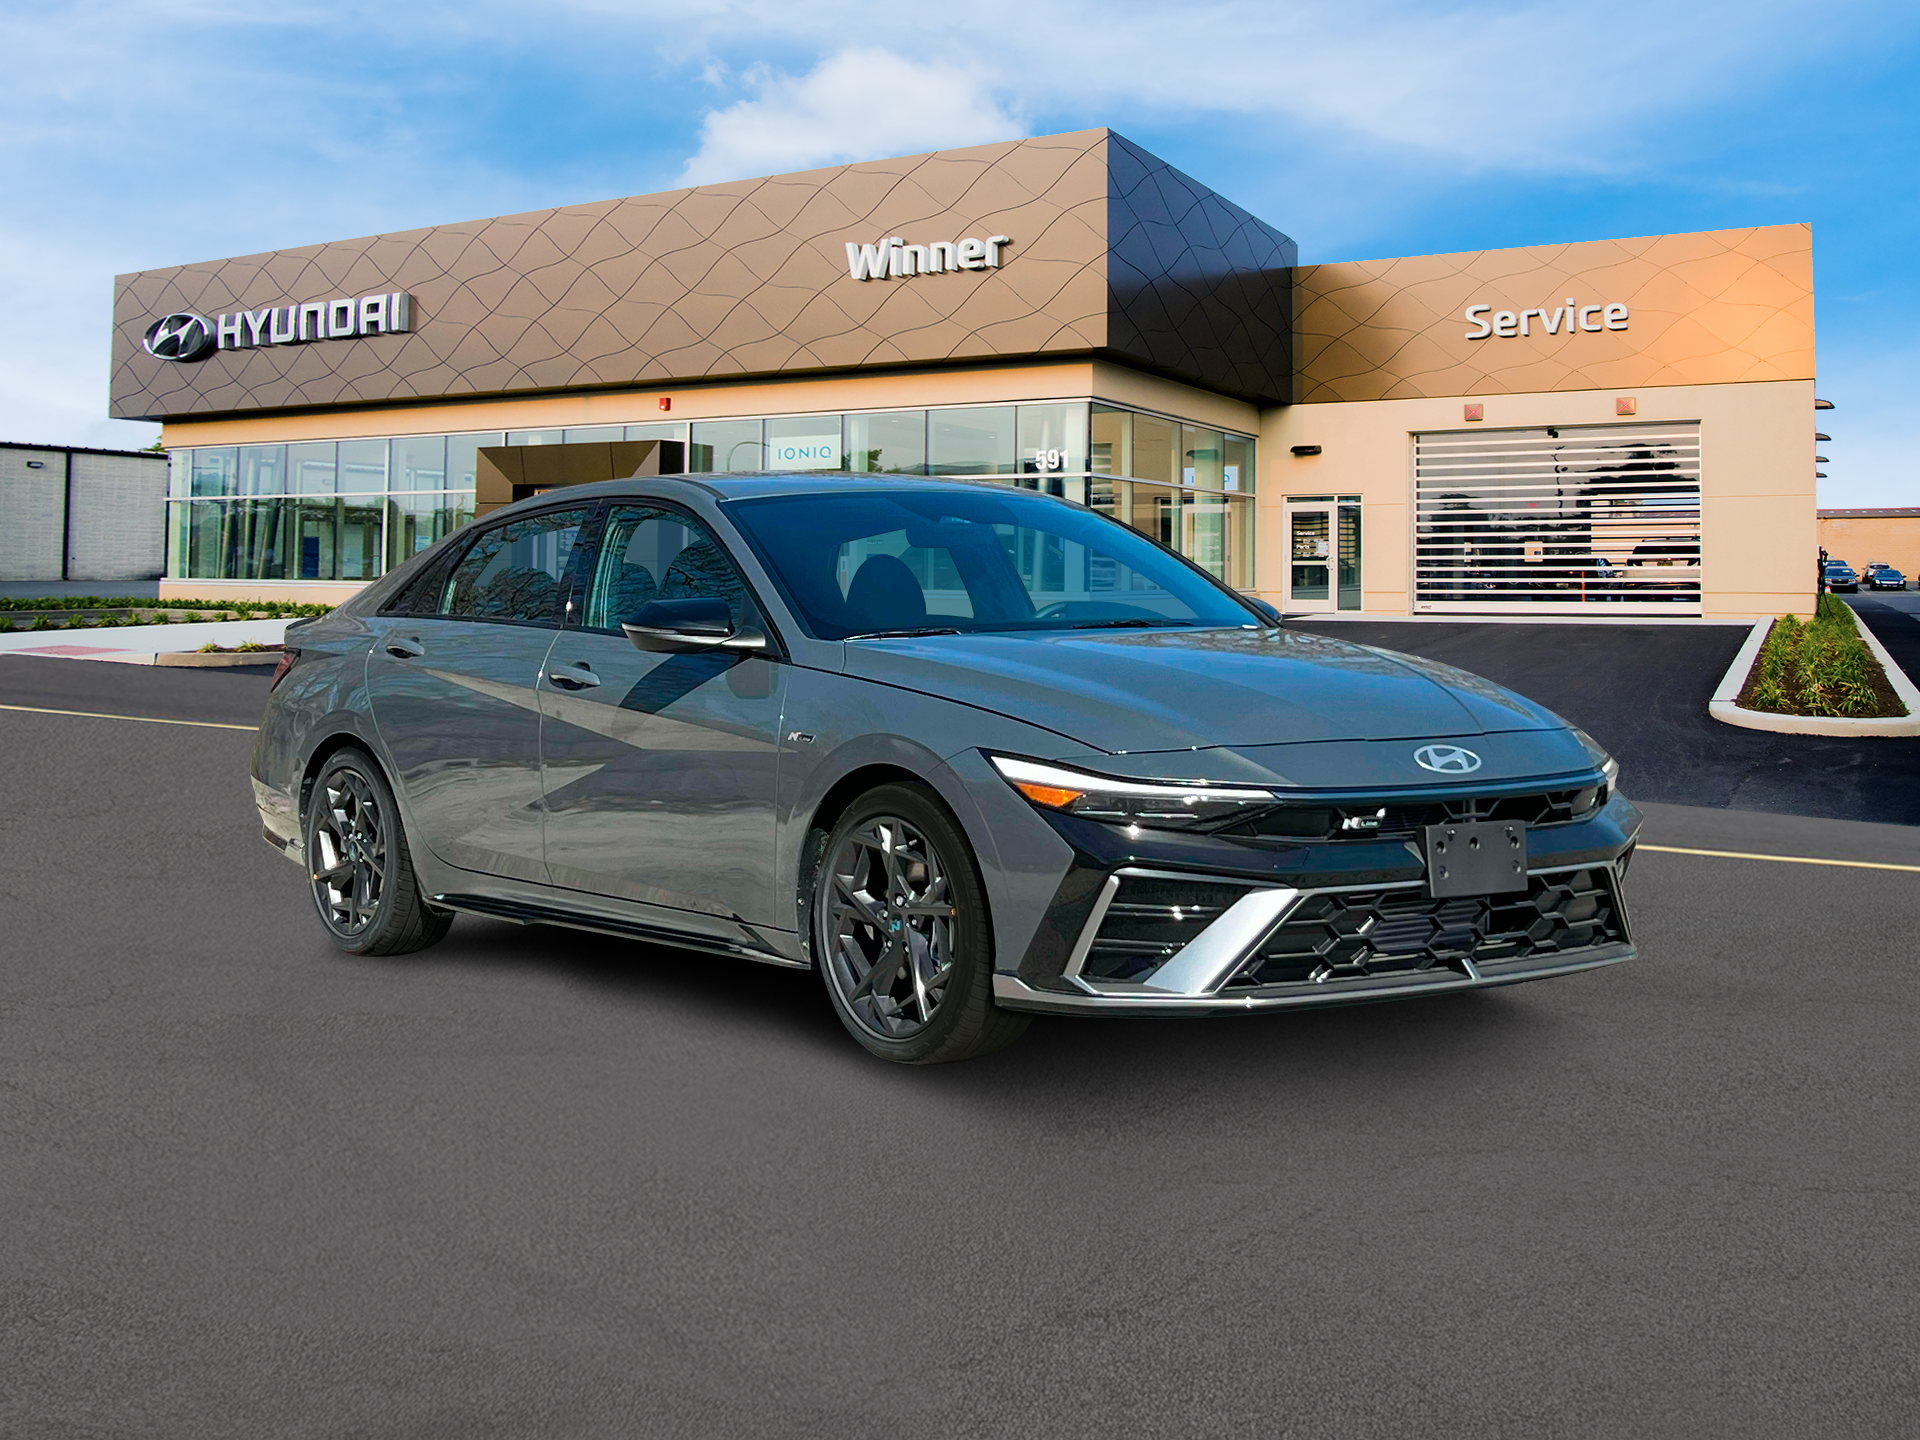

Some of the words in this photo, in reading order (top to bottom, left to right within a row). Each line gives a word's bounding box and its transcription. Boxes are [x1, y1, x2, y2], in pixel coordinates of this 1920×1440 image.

[845, 235, 1010, 281] Winner
[216, 291, 410, 349] HYUNDAI
[1464, 297, 1629, 340] Service
[778, 446, 832, 460] IONIQ
[1035, 449, 1069, 470] 591
